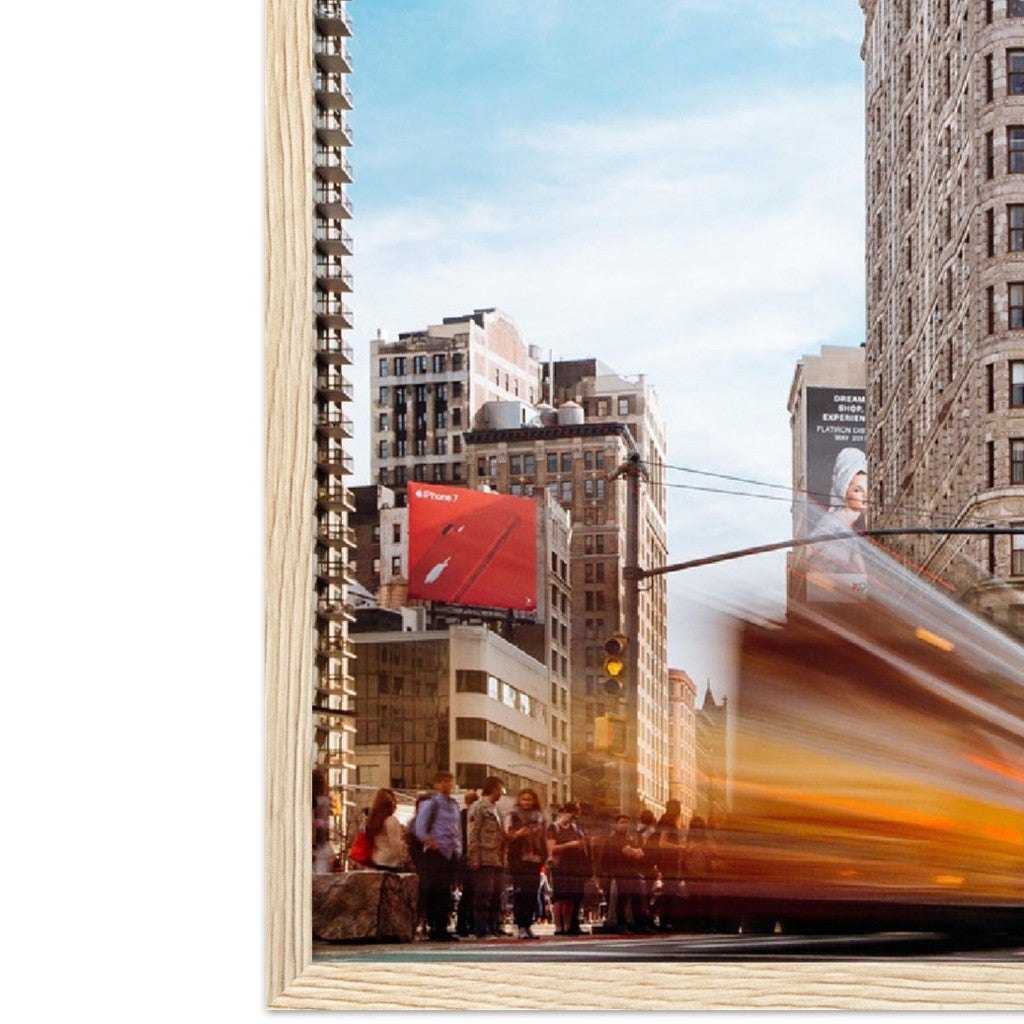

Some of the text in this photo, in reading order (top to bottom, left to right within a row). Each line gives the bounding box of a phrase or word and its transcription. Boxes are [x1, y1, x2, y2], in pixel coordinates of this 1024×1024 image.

[833, 395, 866, 403] DREAM
[422, 490, 459, 503] iPhone 7
